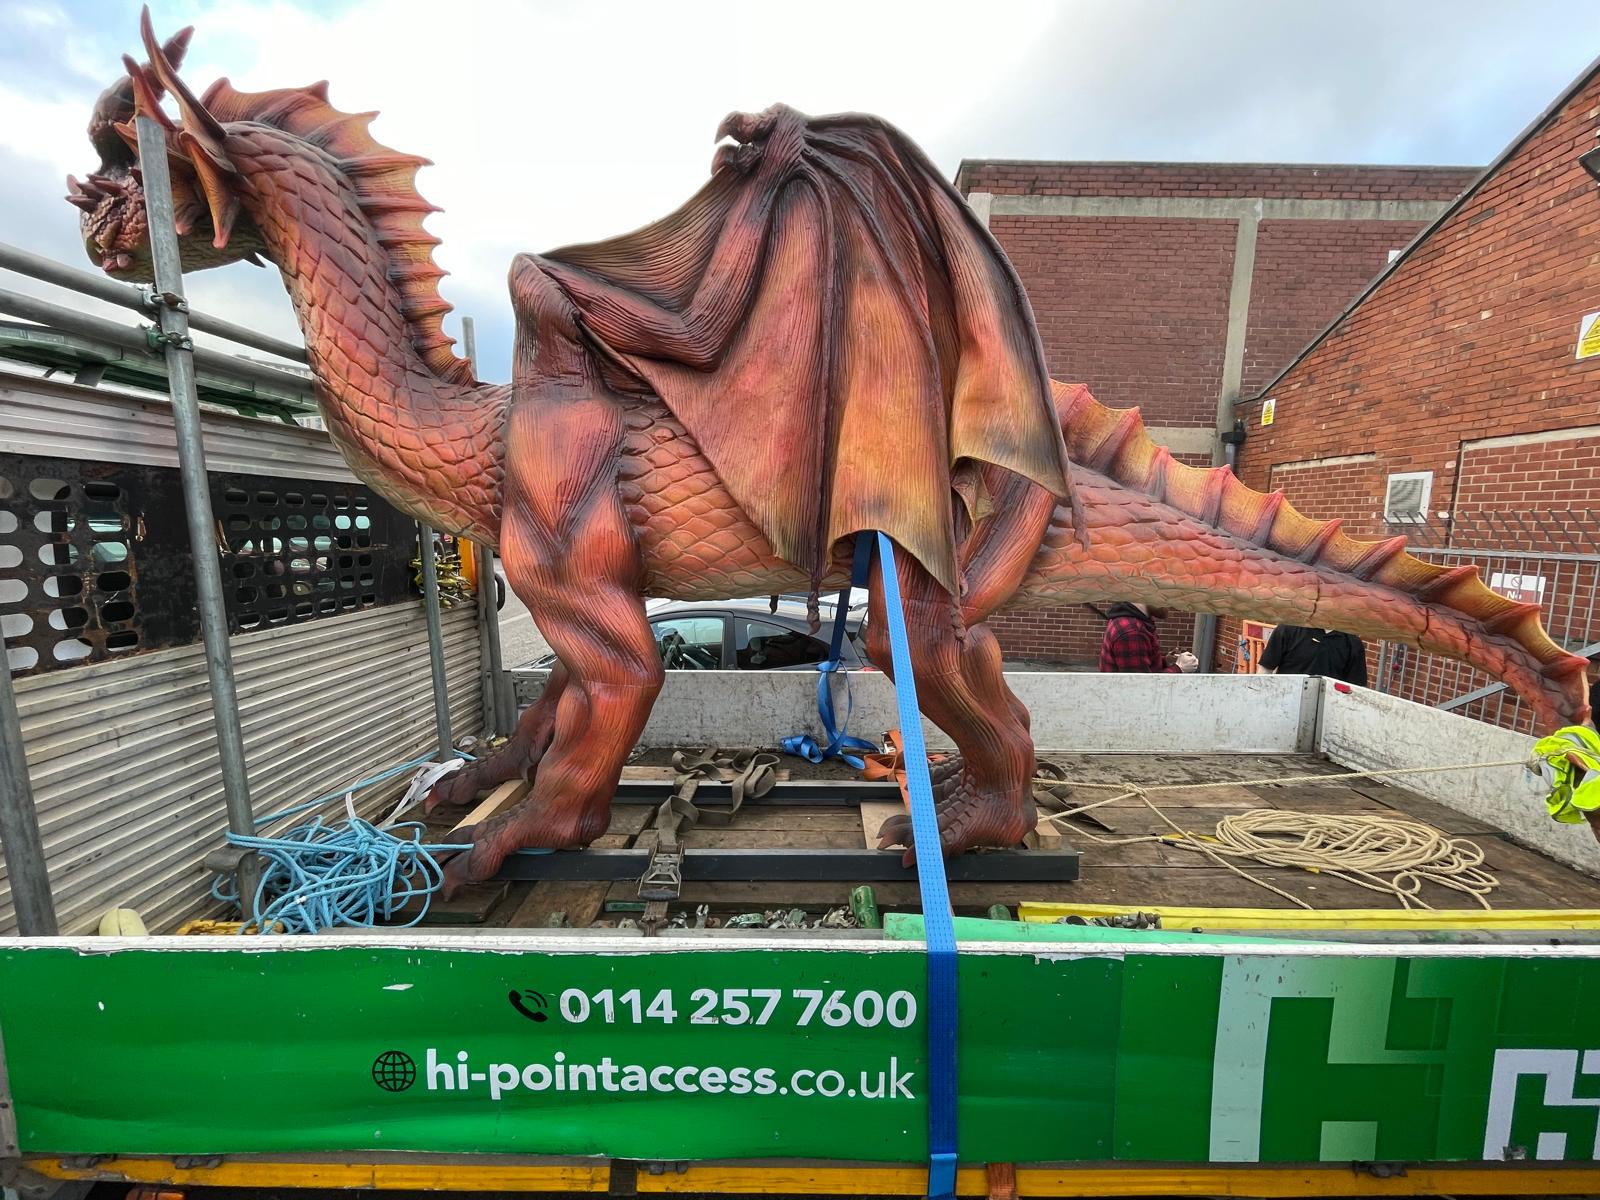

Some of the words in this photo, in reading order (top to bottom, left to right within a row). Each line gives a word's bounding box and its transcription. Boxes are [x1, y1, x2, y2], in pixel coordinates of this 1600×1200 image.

[559, 988, 678, 1025] 0114
[690, 988, 782, 1026] 257
[792, 989, 917, 1028] 7600
[426, 1048, 915, 1100] hi-pointaccess.co.uk
